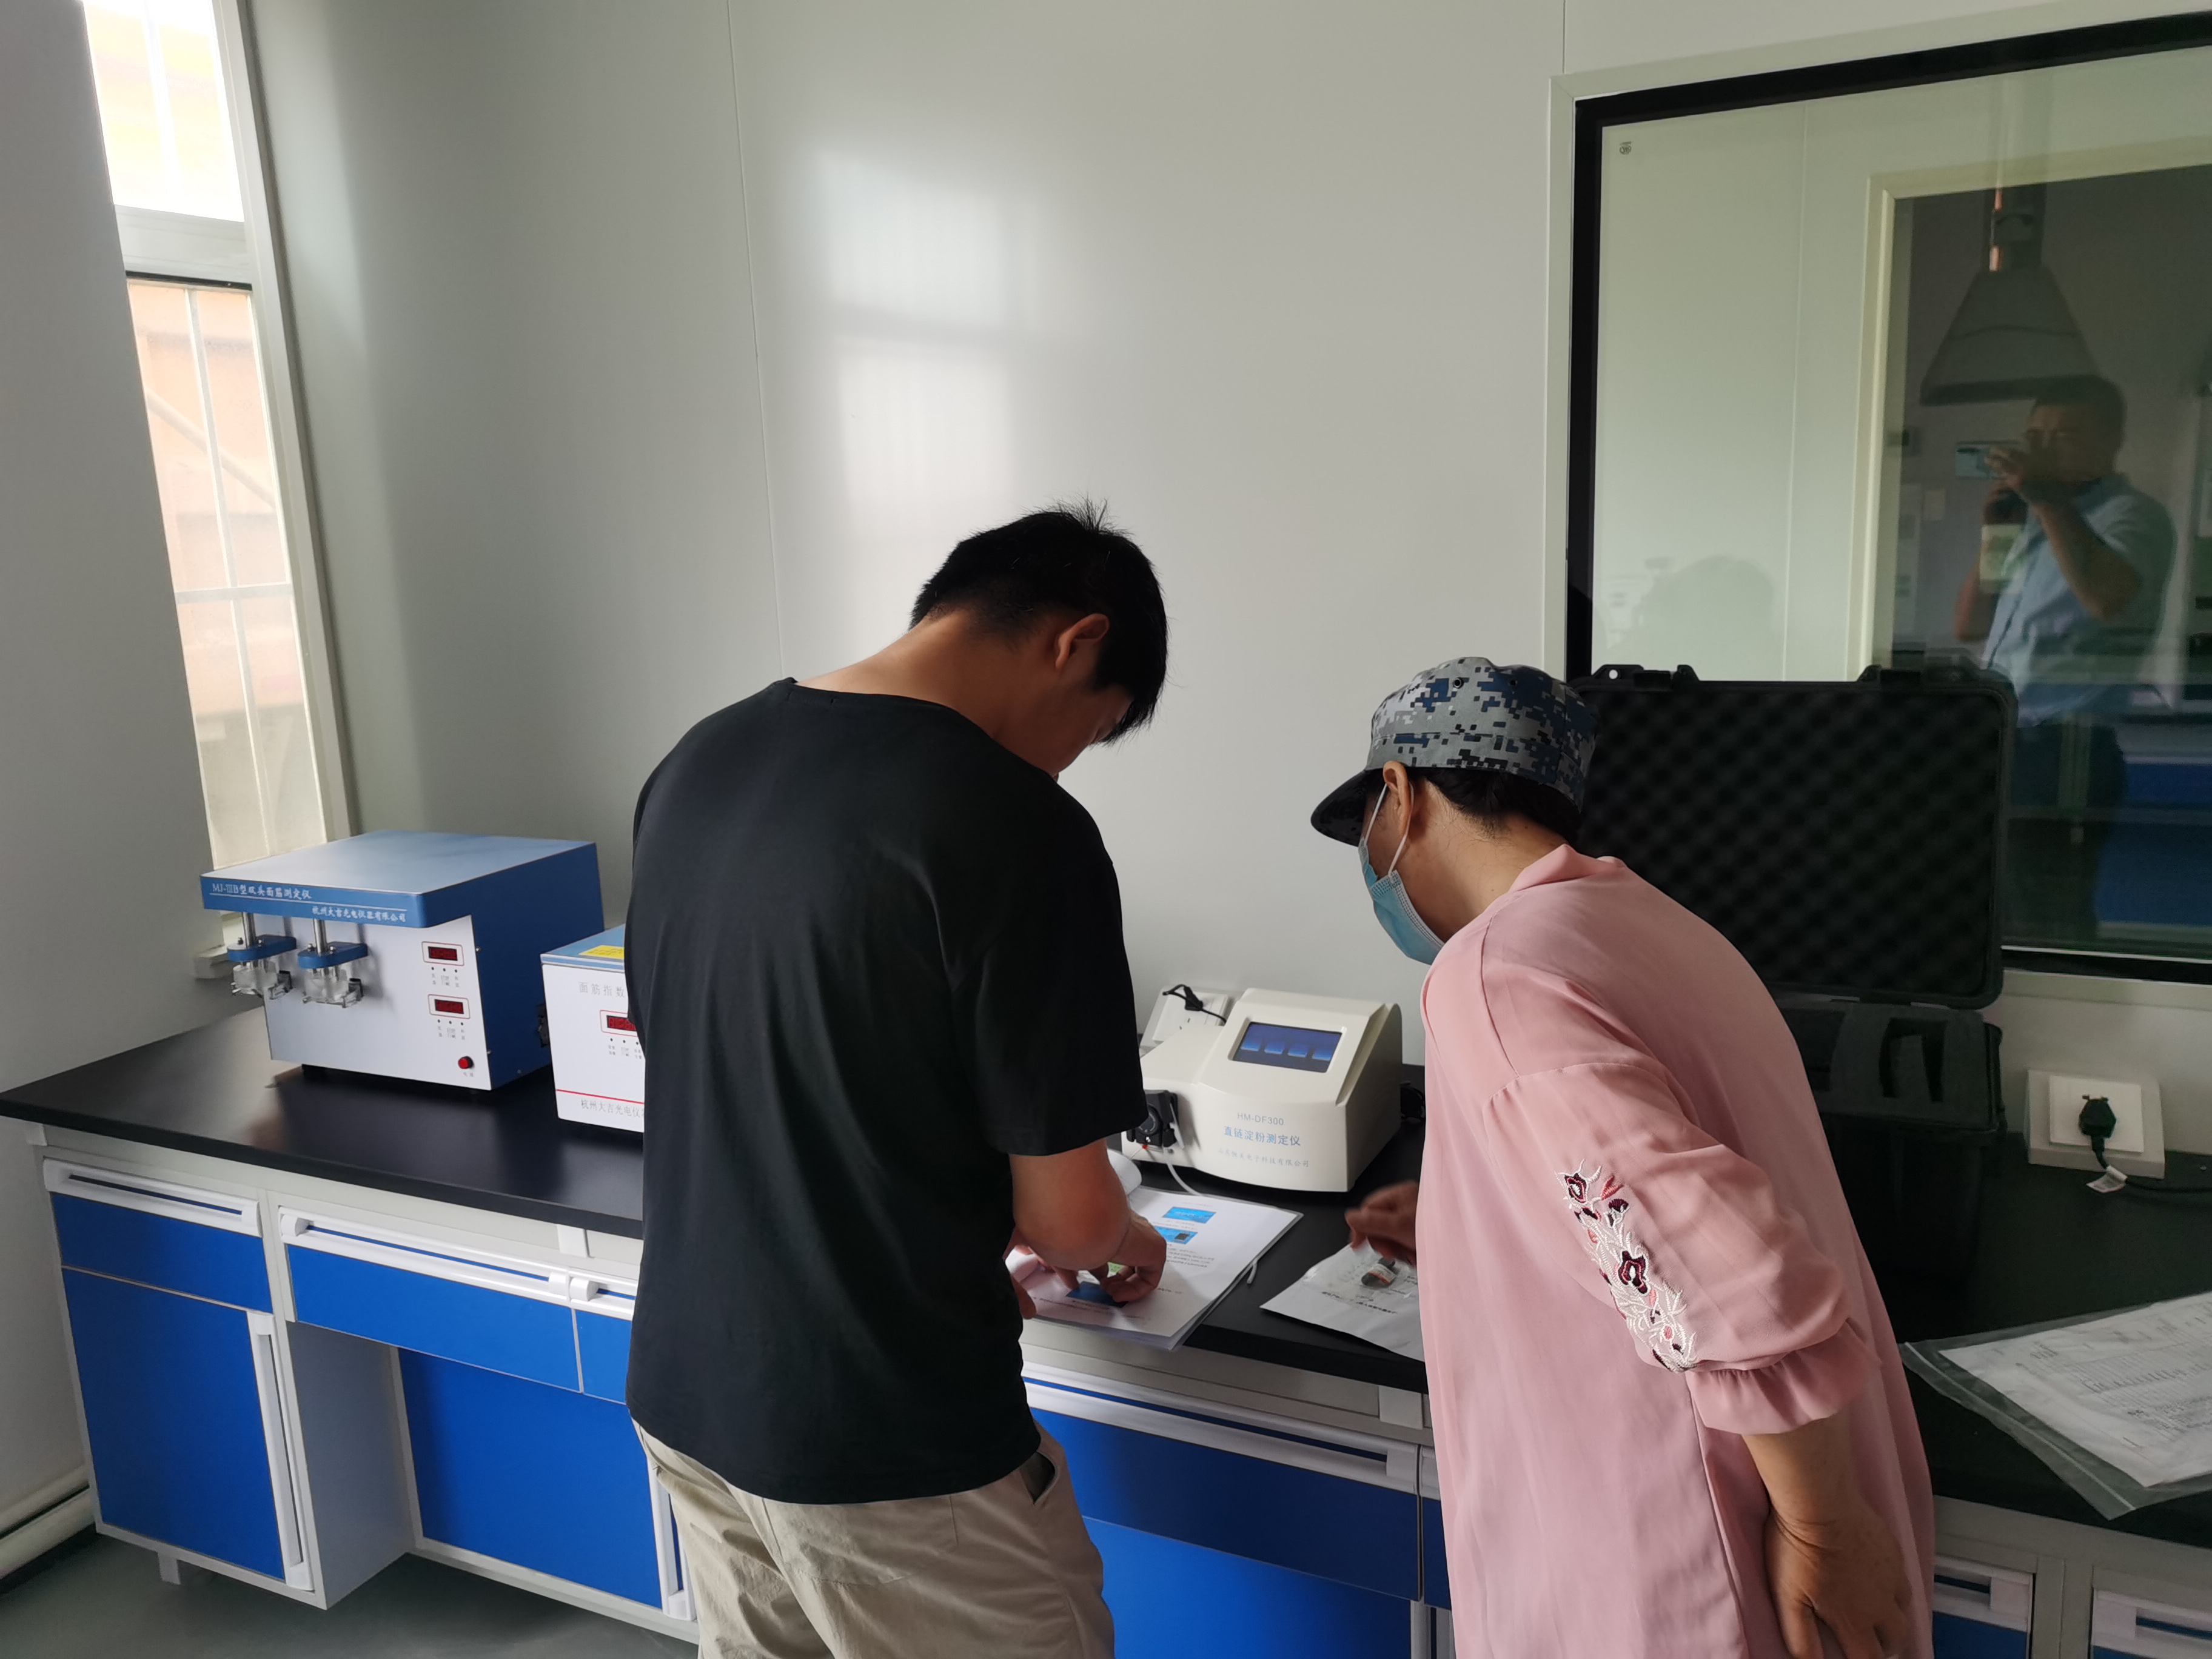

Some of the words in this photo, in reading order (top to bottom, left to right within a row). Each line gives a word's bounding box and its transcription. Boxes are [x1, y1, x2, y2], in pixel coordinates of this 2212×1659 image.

[1237, 1112, 1284, 1126] HM-DF300
[1224, 1125, 1301, 1146] 直链淀粉测定仪
